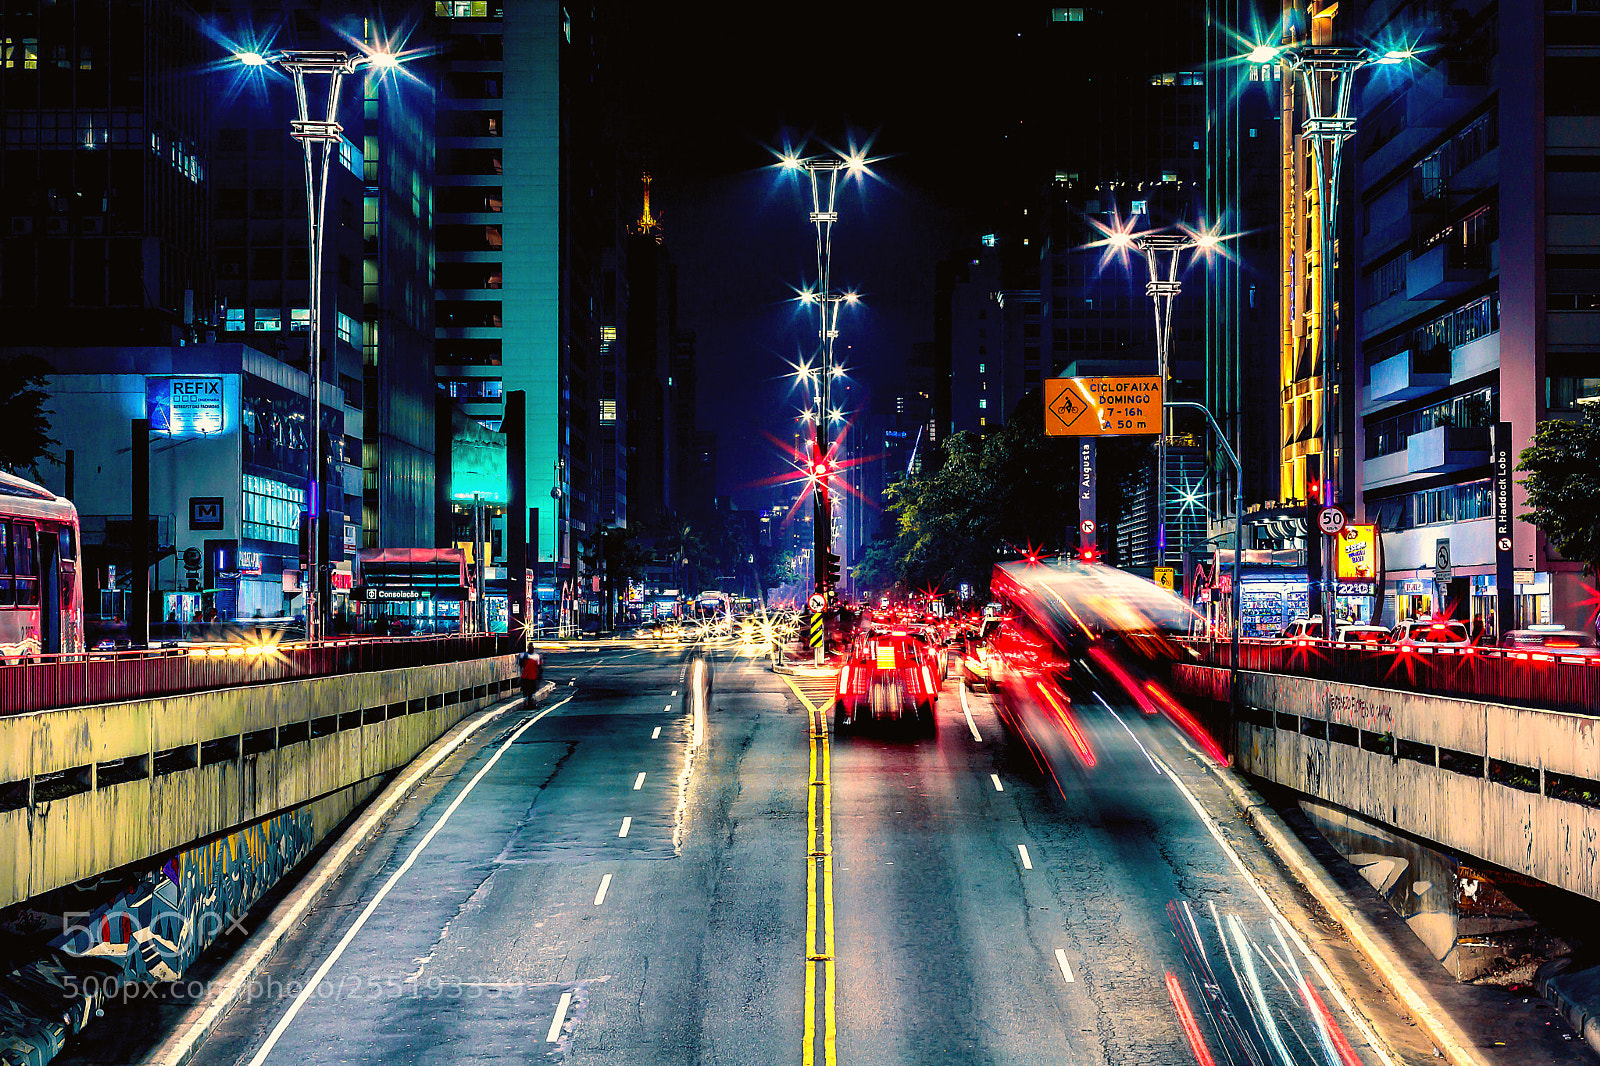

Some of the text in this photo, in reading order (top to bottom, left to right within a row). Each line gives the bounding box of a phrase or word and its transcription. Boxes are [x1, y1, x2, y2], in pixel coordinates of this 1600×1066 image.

[173, 382, 219, 394] REFIX
[1090, 382, 1159, 392] CICLOFAIXA
[1099, 394, 1150, 404] DOMINGO
[1107, 407, 1114, 416] 7
[1124, 407, 1143, 416] 16h
[1104, 420, 1112, 429] A
[1117, 420, 1133, 429] 50
[1081, 444, 1093, 487] Augusta
[1497, 450, 1507, 534] R. Haddock Lobo
[1323, 512, 1342, 525] 50
[378, 590, 419, 600] Consolação
